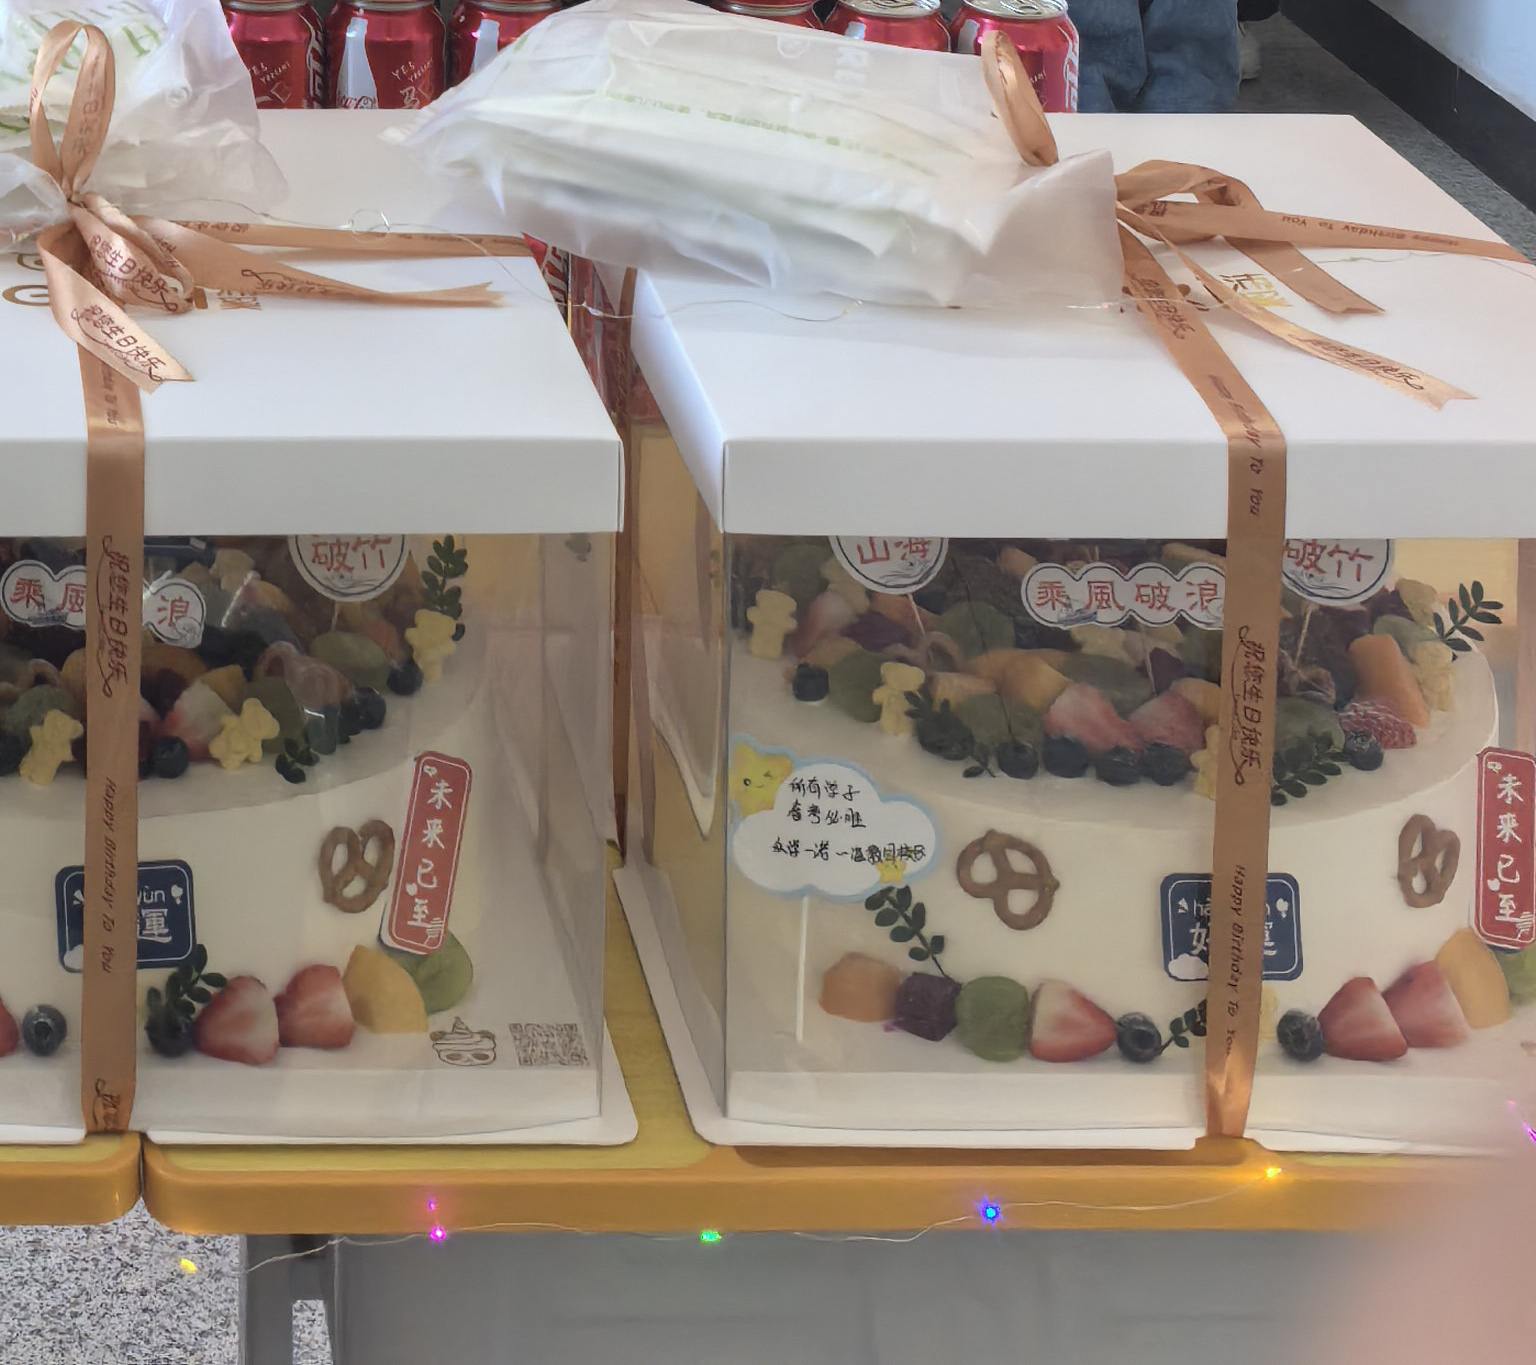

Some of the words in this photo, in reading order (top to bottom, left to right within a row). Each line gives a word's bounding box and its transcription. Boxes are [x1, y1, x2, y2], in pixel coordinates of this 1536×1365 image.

[312, 537, 391, 571] 破竹
[1036, 579, 1219, 612] 乘風破浪
[103, 777, 117, 830] Happy
[103, 834, 117, 905] Birthday
[1230, 864, 1245, 919] Happy
[1229, 922, 1244, 994] Birthday
